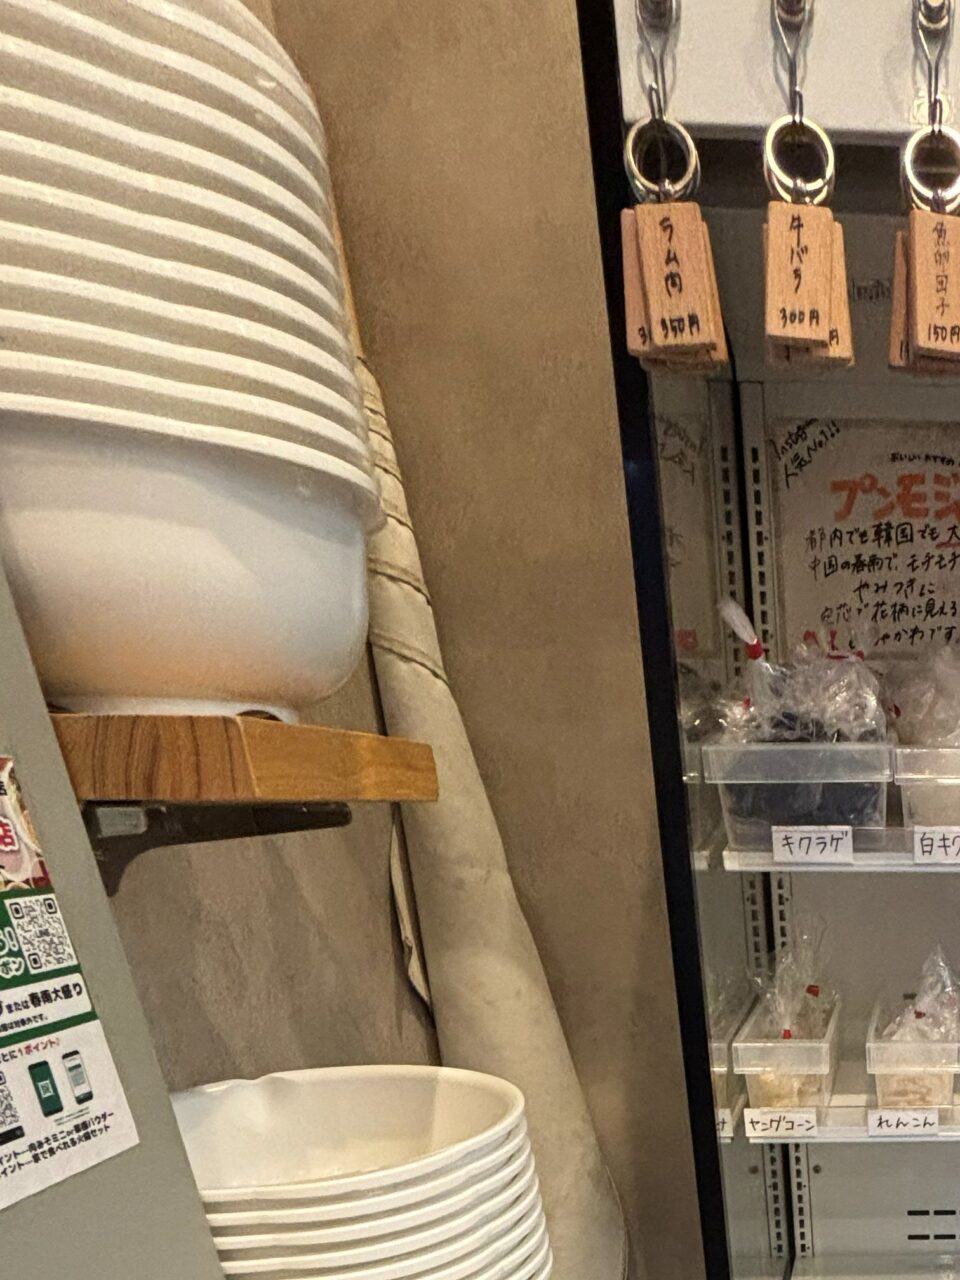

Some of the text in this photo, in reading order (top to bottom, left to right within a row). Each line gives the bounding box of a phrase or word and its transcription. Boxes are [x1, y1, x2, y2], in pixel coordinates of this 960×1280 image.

[789, 215, 808, 293] 牛バラ
[779, 307, 820, 328] 300円
[927, 325, 960, 344] 150円
[781, 831, 849, 857] キクラゲ
[0, 982, 83, 1015] または春雨大盛り
[748, 1115, 816, 1133] ヤングコーン
[876, 1115, 936, 1130] れんこん
